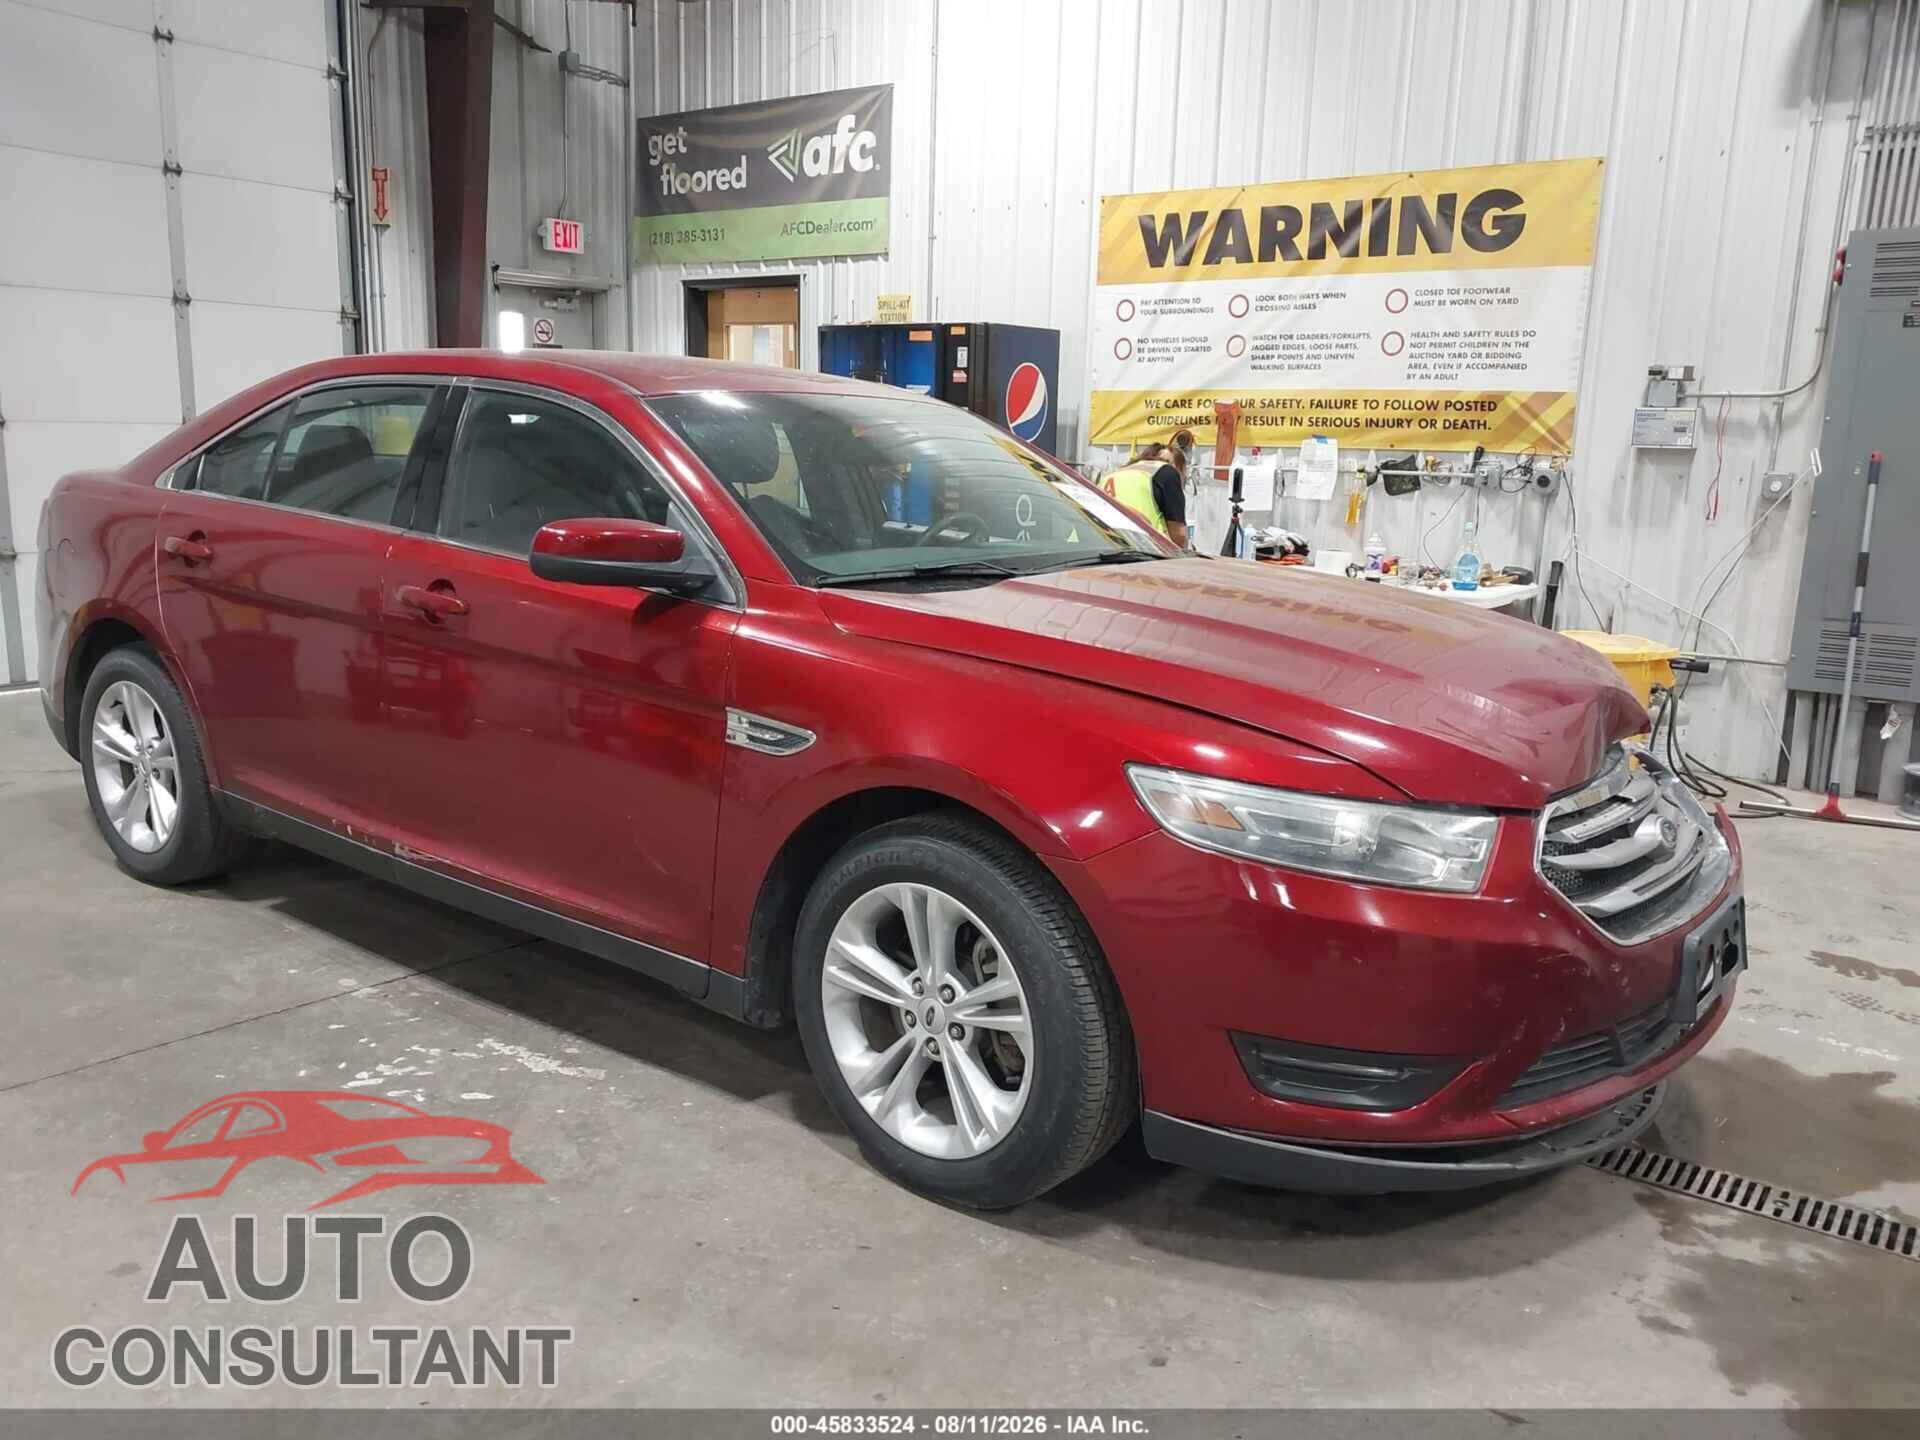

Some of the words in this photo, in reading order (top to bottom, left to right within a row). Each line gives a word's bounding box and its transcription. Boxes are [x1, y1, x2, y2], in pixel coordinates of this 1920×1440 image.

[648, 127, 688, 165] get
[802, 114, 877, 177] afc
[660, 155, 748, 195] floored
[780, 218, 875, 237] AFCDealer.com
[1137, 188, 1527, 269] WARNING
[553, 221, 579, 249] EXIT
[649, 228, 674, 246] (218)
[677, 227, 726, 245] 385-3131
[1299, 292, 1320, 300] WAYS
[1463, 287, 1511, 295] FOOTWEAR
[1255, 304, 1291, 312] CROSSING
[1479, 298, 1494, 306] ON
[1442, 330, 1460, 338] AND
[1463, 330, 1491, 338] SAFETY
[1324, 352, 1355, 360] UNEVEN
[1465, 362, 1528, 370] ACCOMPANIED
[1145, 399, 1162, 409] WE
[1164, 399, 1194, 409] CARE
[1309, 399, 1359, 411] FAILURE
[1362, 399, 1380, 410] TO
[1384, 400, 1439, 411] FOLLOW
[1444, 400, 1498, 412] POSTED
[1147, 415, 1212, 426] GUIDELINES
[1244, 416, 1285, 426] RESULT
[1289, 416, 1305, 427] IN
[1308, 416, 1361, 428] SERIOUS
[1365, 417, 1412, 429] INJURY
[1417, 417, 1438, 429] OR
[1443, 418, 1492, 431] DEATH.
